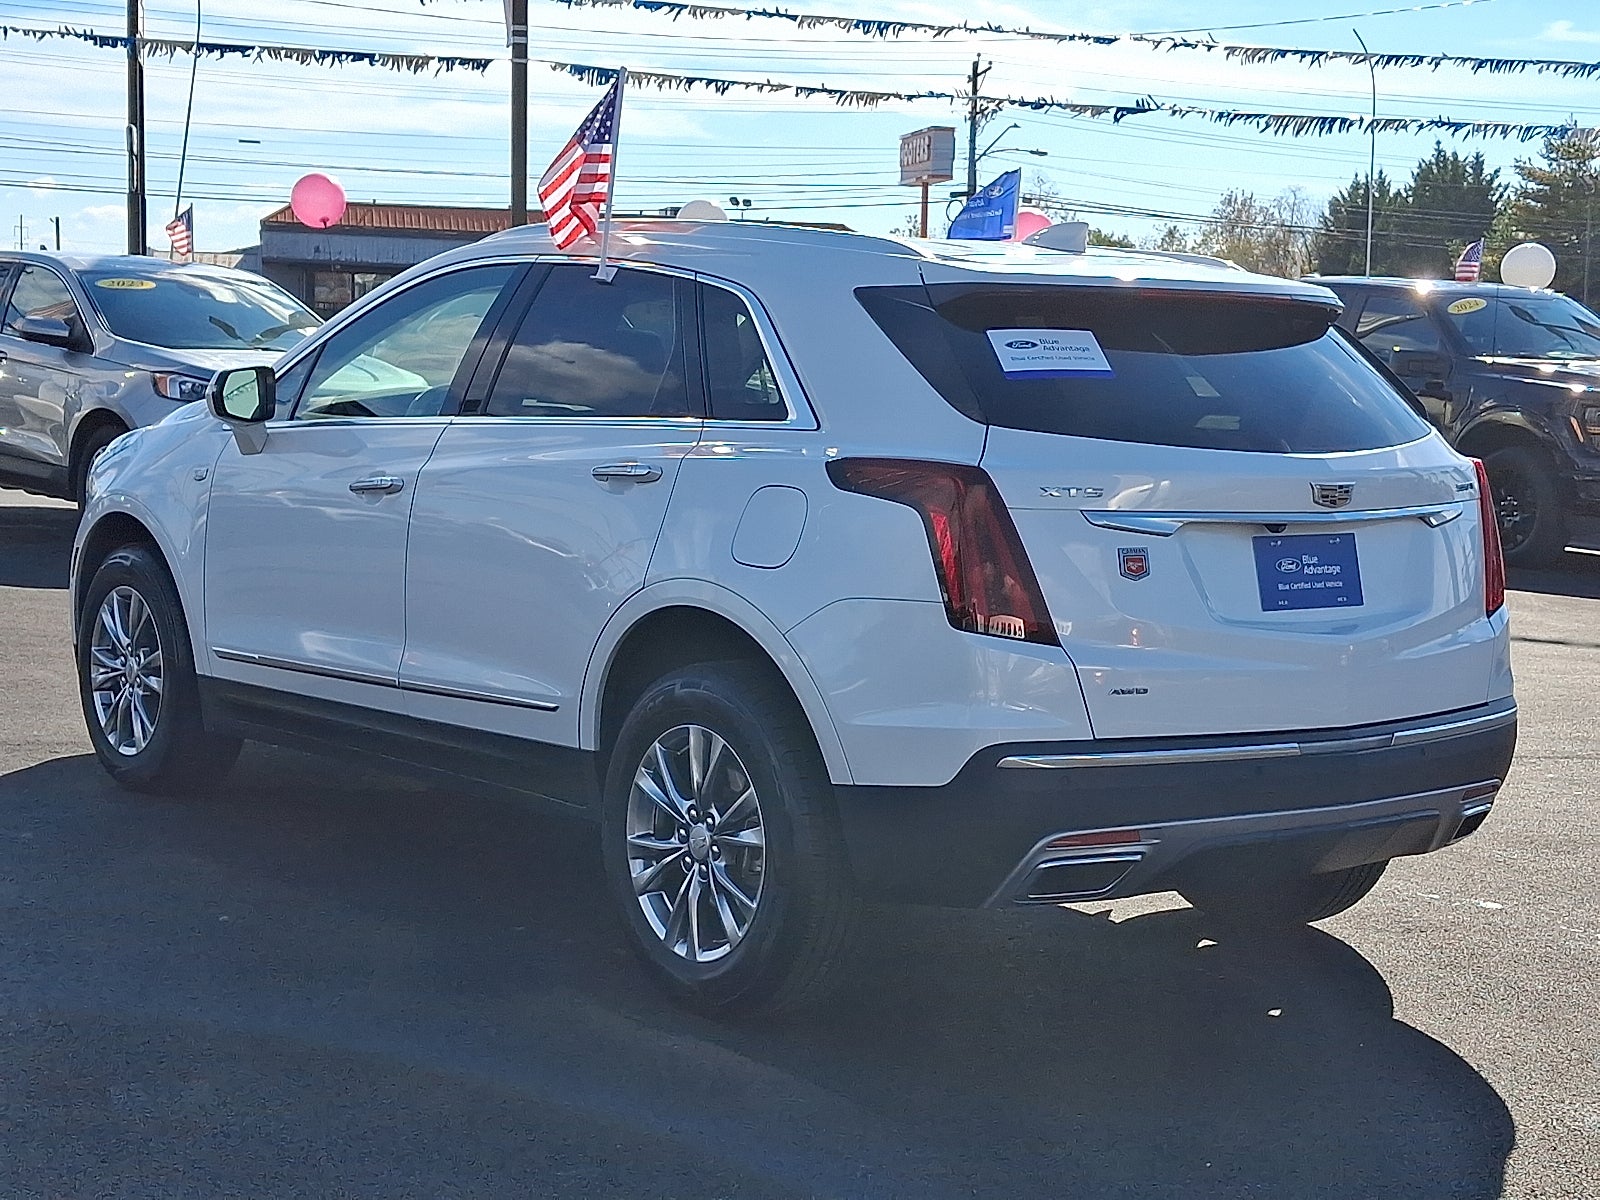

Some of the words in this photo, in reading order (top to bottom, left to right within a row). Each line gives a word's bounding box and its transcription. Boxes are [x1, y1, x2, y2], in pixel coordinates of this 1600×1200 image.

[1010, 340, 1034, 350] Ford
[1043, 345, 1090, 353] Advantage
[1302, 555, 1318, 564] Blue
[1279, 560, 1299, 572] Ford
[1303, 564, 1341, 575] Advantage
[1290, 582, 1311, 590] Certified
